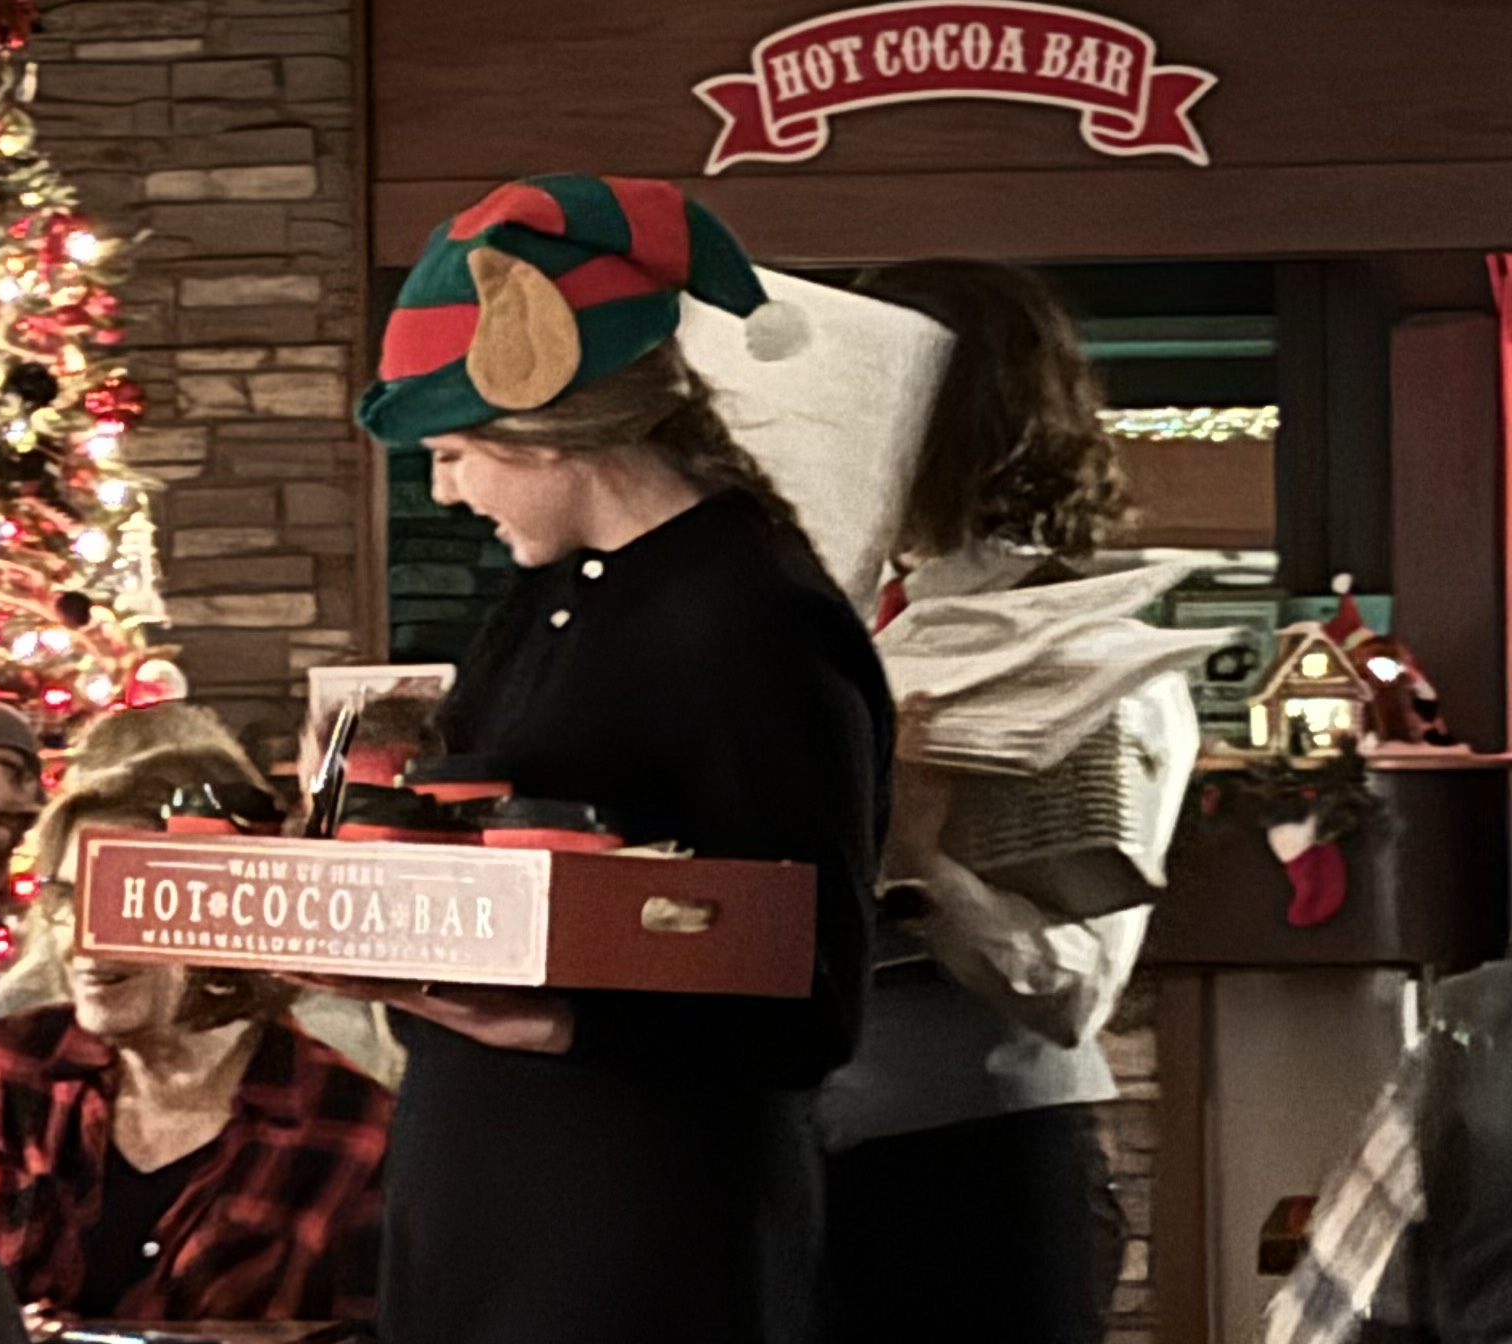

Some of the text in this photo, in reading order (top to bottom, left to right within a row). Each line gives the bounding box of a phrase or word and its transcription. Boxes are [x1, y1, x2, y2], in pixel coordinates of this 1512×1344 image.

[768, 22, 1136, 102] HOT COCOA BAR
[228, 859, 288, 880] WARM
[121, 876, 495, 939] HOT COCOA BAR
